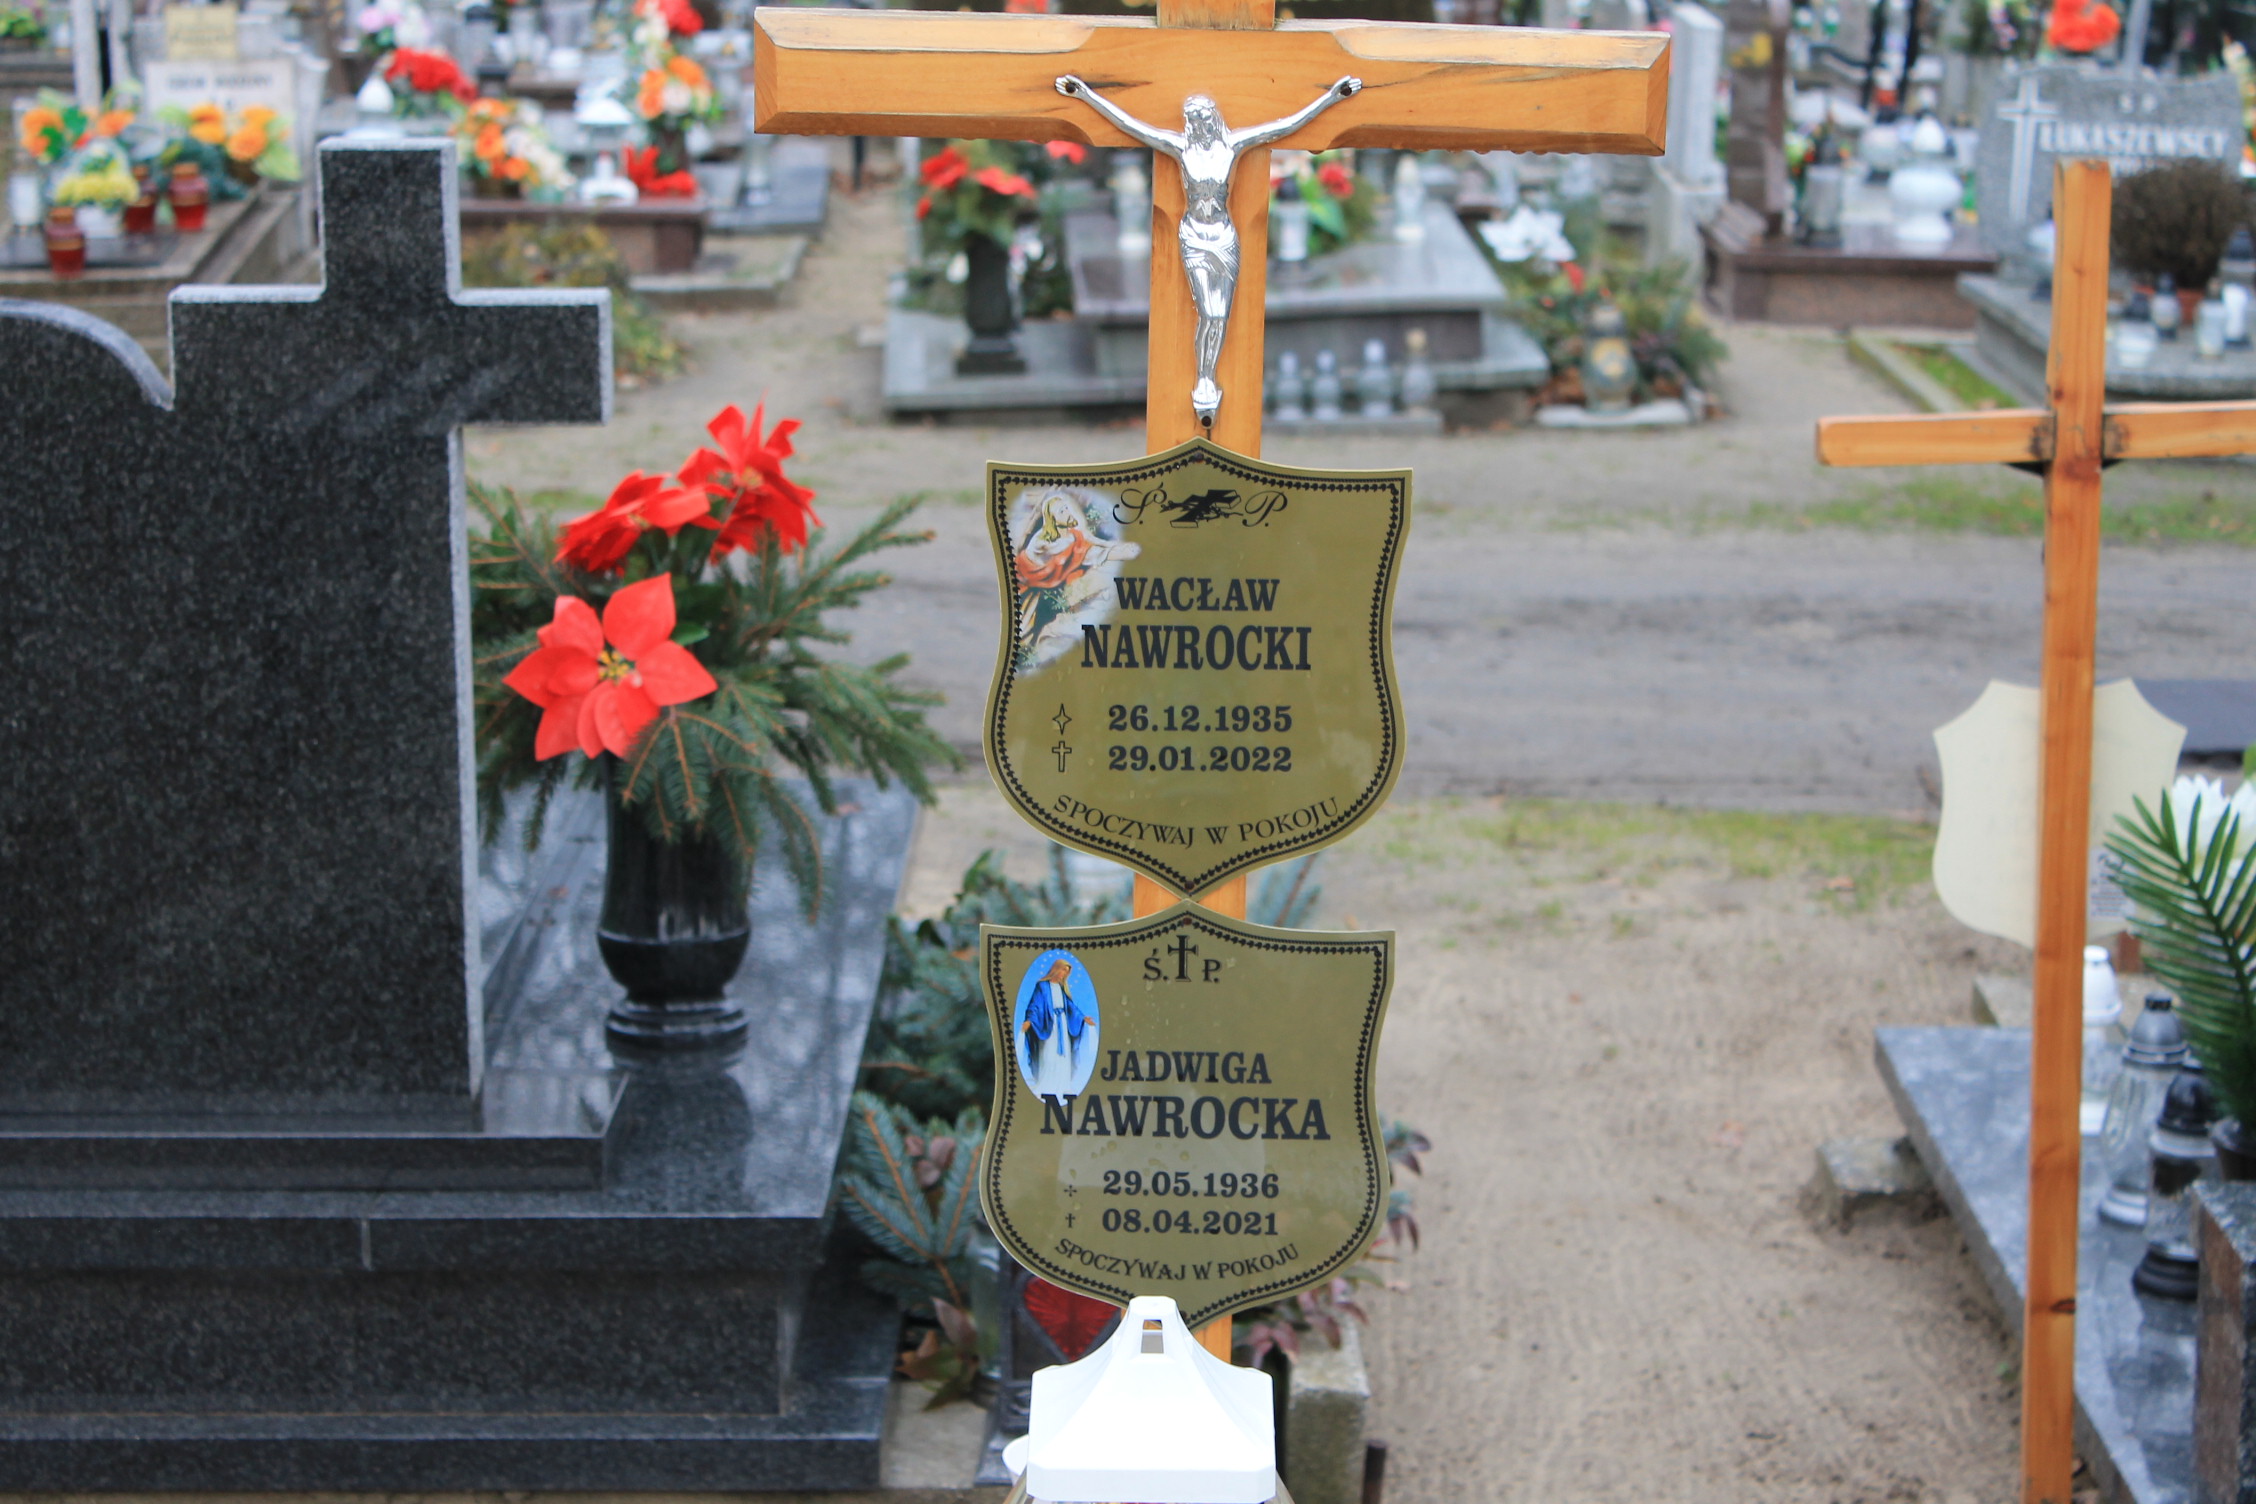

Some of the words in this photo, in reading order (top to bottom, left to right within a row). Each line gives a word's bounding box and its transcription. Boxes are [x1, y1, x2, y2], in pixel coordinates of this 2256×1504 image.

[1114, 577, 1280, 612] WACŁAW
[1081, 624, 1312, 671] NAWROCKI
[1108, 705, 1293, 732] 26.12.1935
[1108, 745, 1293, 772] 29.01.2022
[1053, 794, 1194, 849] SPOCZYWAJ
[1204, 826, 1228, 846] W
[1237, 797, 1339, 842] POKOJU
[1101, 1050, 1272, 1084] JADWIGA
[1040, 1094, 1331, 1140] NAWROCKA
[1103, 1170, 1280, 1199] 29.05.1936
[1102, 1208, 1279, 1236] 08.04.2021
[1054, 1238, 1186, 1280] SPOCZYWAJ
[1192, 1260, 1212, 1280] W
[1217, 1243, 1299, 1279] POKOJU
